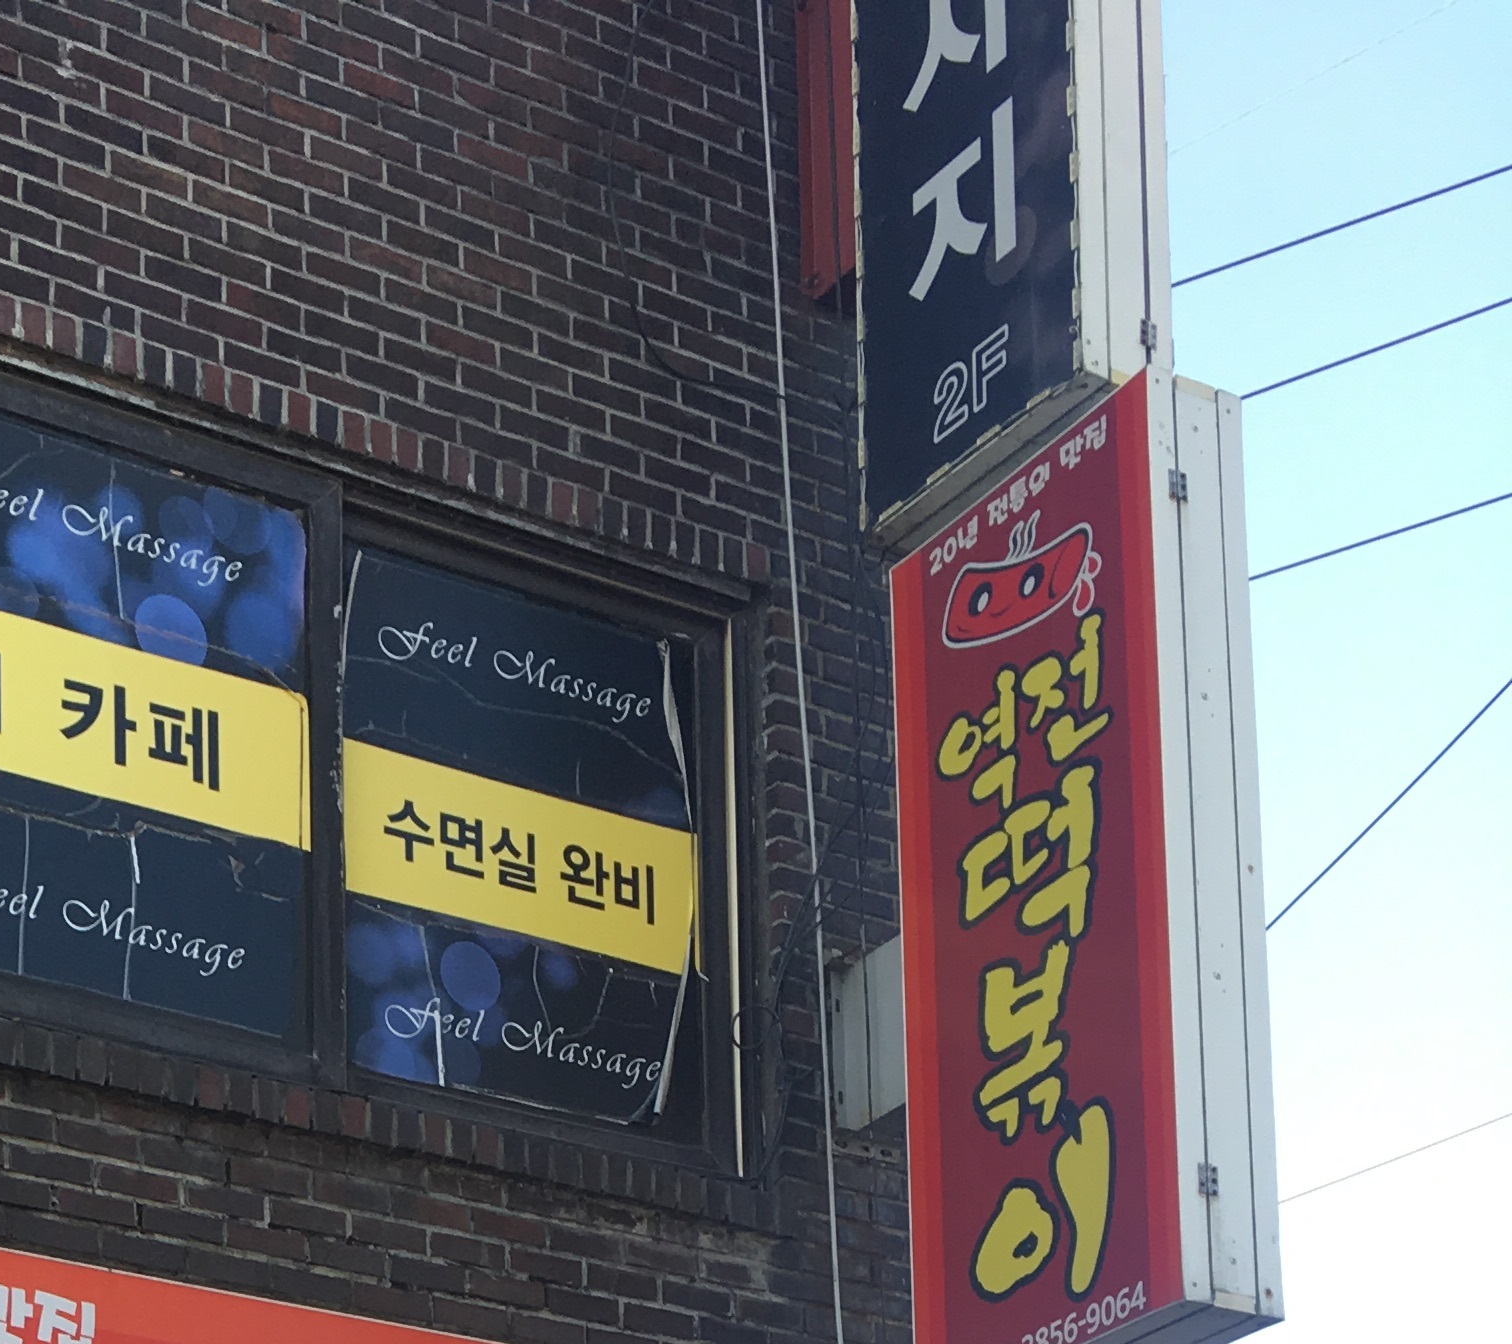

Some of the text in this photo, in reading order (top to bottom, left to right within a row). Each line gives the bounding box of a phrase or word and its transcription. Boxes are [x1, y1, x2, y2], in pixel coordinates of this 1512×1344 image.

[933, 323, 1010, 445] 2F
[62, 503, 244, 587] Massage
[929, 414, 1108, 575] 20년 전통의 맛집
[378, 622, 651, 723] Feel Massage
[60, 678, 221, 792] 카페
[383, 799, 656, 925] 수면실 완비
[62, 899, 246, 977] Massage
[502, 1021, 662, 1094] Massage
